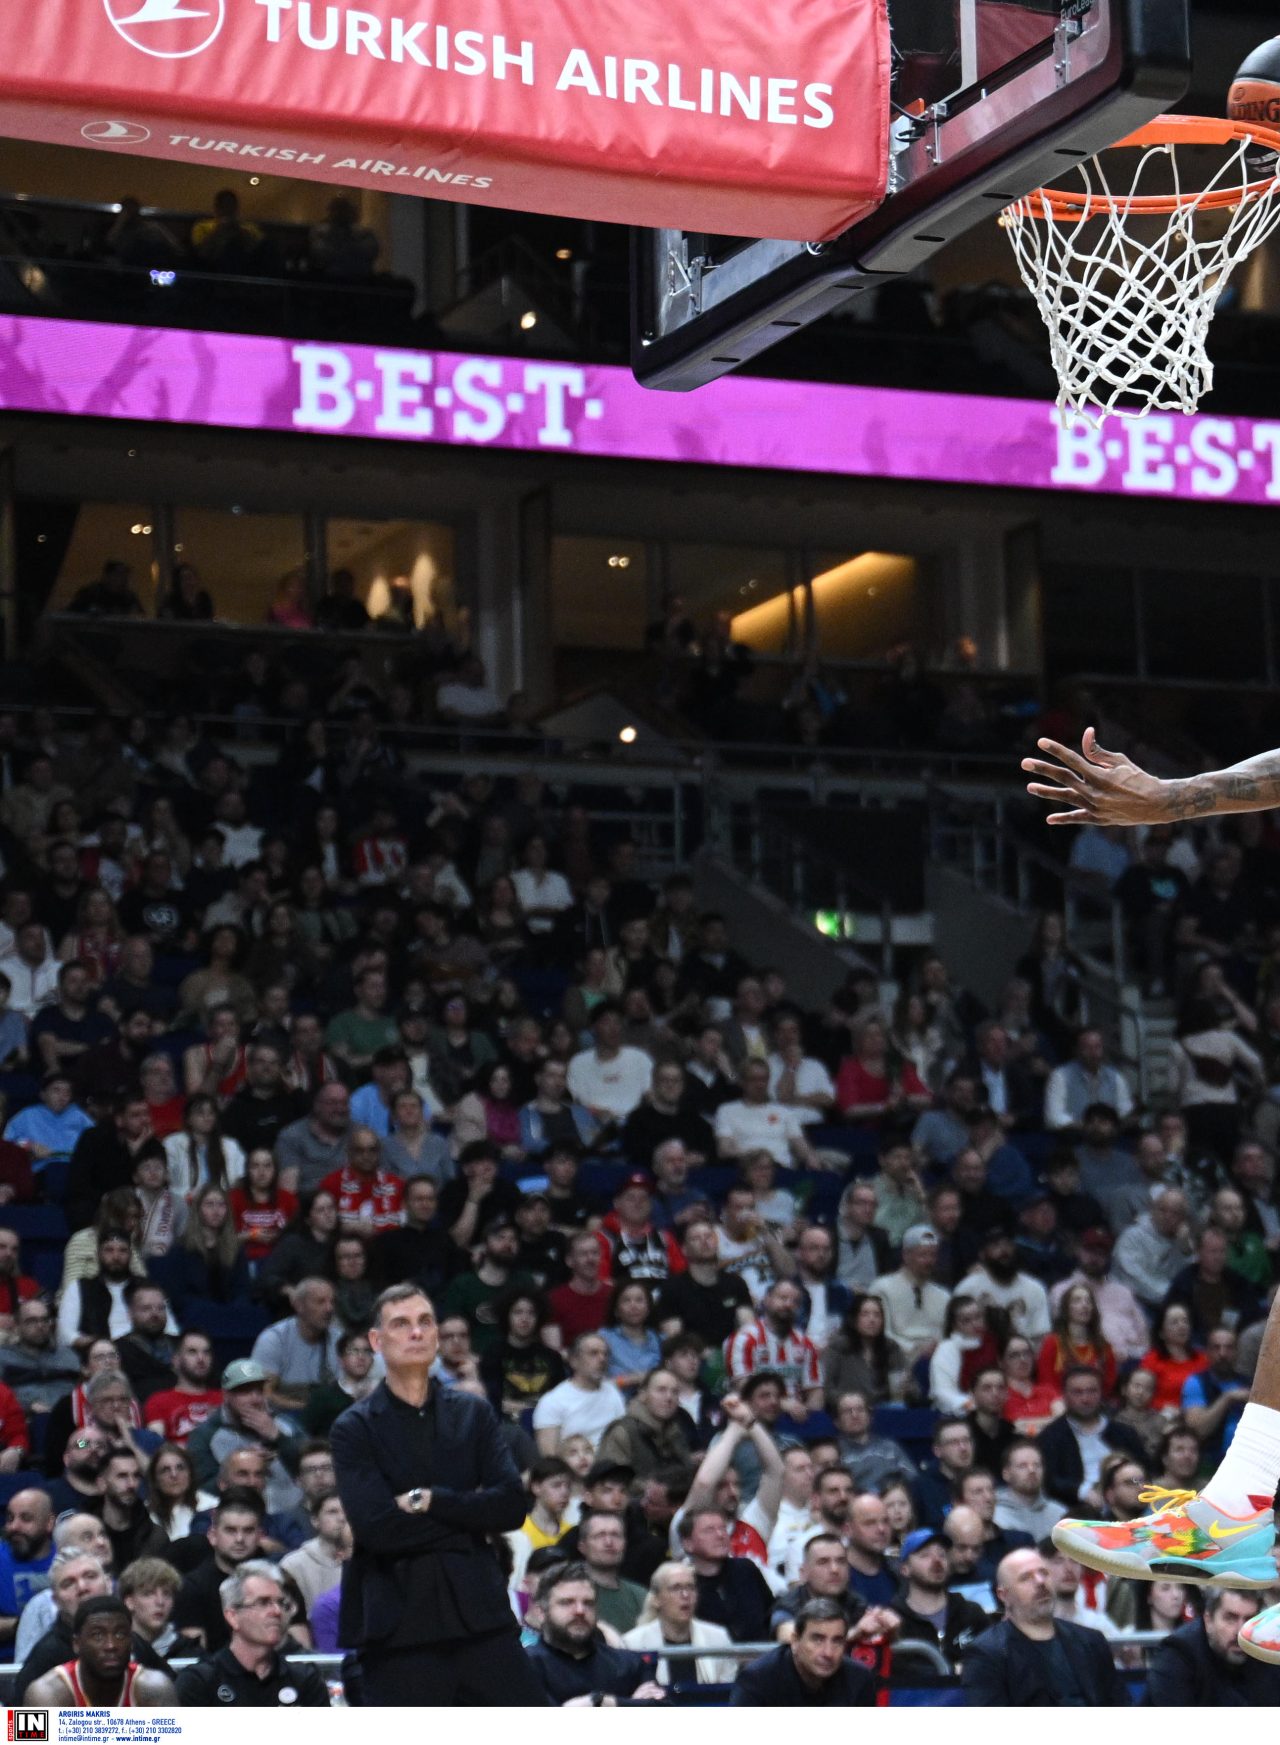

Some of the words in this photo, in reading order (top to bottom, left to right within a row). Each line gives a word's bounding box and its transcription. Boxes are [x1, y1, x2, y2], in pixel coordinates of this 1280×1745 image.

[255, 0, 534, 86] TURKISH
[555, 48, 834, 129] AIRLINES
[168, 134, 326, 165] TURKISH
[331, 158, 493, 189] AIRLINES
